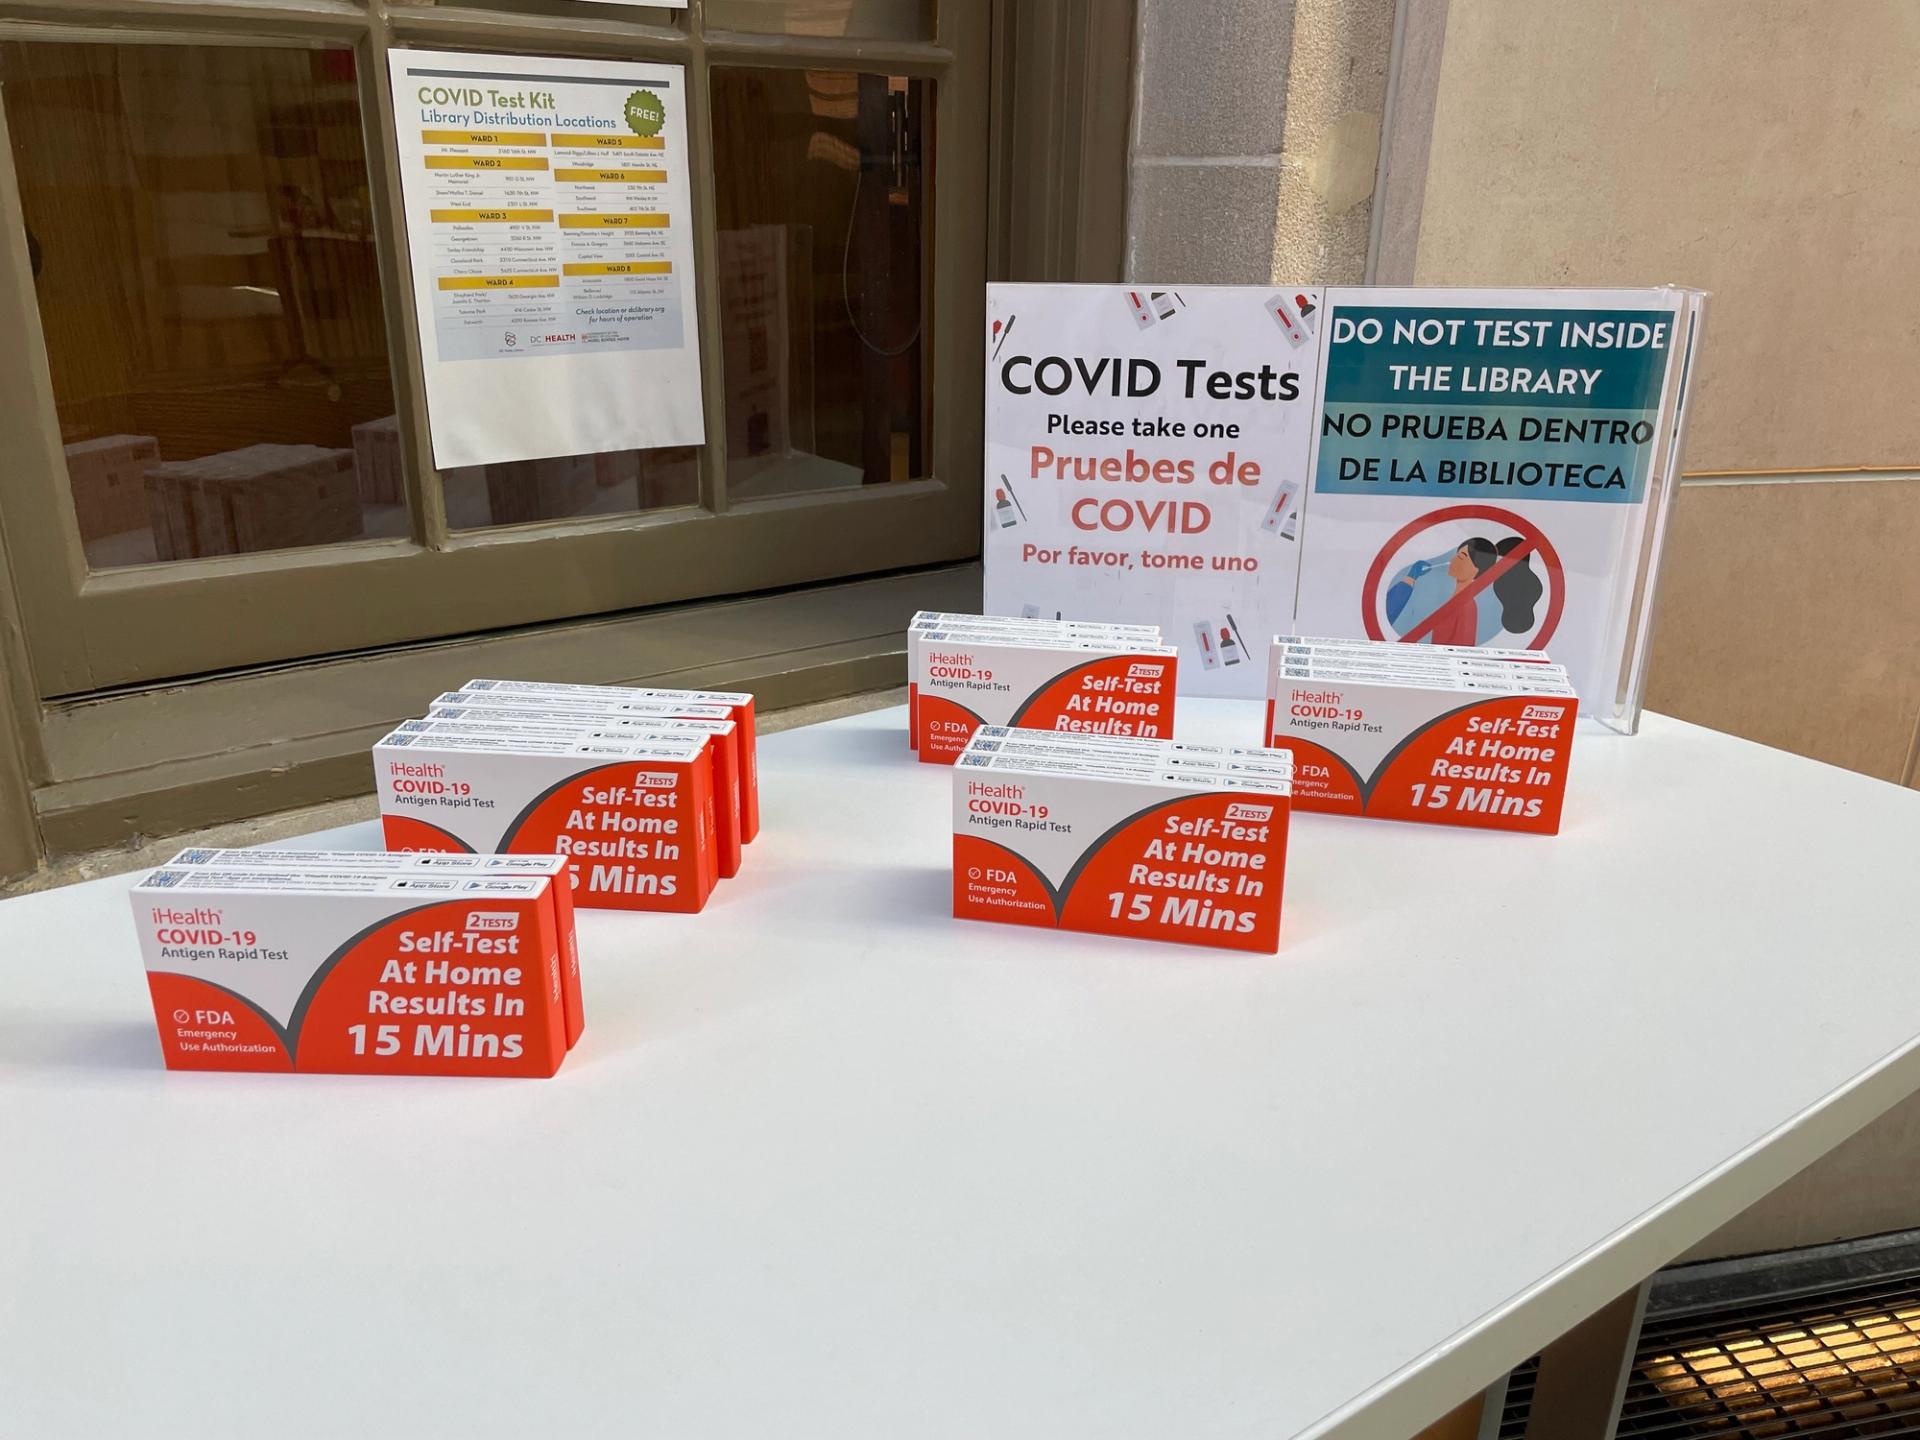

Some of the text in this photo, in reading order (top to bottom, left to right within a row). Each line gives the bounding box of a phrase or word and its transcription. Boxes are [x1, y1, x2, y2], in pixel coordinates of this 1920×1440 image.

[418, 86, 556, 110] COVID Test Kit
[421, 109, 616, 129] Library Distribution Locations
[630, 107, 660, 122] FREE!
[576, 307, 595, 315] Check
[596, 306, 619, 314] location
[628, 305, 665, 314] dclibrary.org
[589, 316, 598, 324] for
[617, 315, 624, 323] of
[624, 314, 653, 323] operation
[545, 334, 576, 342] HEALTH
[1332, 318, 1666, 350] DO NOT TEST INSIDE
[1001, 356, 1300, 401] COVID Tests
[1390, 365, 1602, 395] THE LIBRARY
[1048, 414, 1240, 438] Please take one
[1322, 413, 1654, 444] NO PRUEBA DENTRO
[1030, 446, 1261, 486] Pruebes de
[1338, 457, 1626, 490] DE LA BIBLIOTECA
[1072, 498, 1212, 534] COVID
[1022, 544, 1258, 571] Por favor, tome uno
[929, 652, 972, 666] iHealth
[930, 666, 992, 680] COVID-19
[930, 679, 1010, 692] Antigen Rapid Test
[1082, 675, 1162, 695] Self-Test
[1066, 694, 1160, 716] At Home
[1292, 690, 1340, 705] iHealth
[1290, 705, 1363, 720] COVID-19
[944, 722, 968, 734] FDA
[1056, 714, 1158, 737] Results In
[1290, 718, 1383, 733] Antigen Rapid Test
[1466, 716, 1560, 739] Self-Test
[930, 743, 944, 751] Use
[1446, 737, 1556, 763] At Home
[390, 762, 442, 778] iHealth
[1302, 765, 1330, 778] FDA
[1430, 758, 1552, 786] Results In
[392, 780, 470, 795] COVID-19
[582, 786, 677, 808] Self-Test
[968, 782, 1024, 799] iHealth
[1300, 789, 1354, 800] Authorization
[394, 796, 495, 809] Antigen Rapid Test
[968, 800, 1048, 818] COVID-19
[1410, 784, 1543, 818] 15 Mins
[566, 810, 679, 834] At Home
[968, 815, 1072, 833] Antigen Rapid Test
[1164, 816, 1270, 842] Self-Test
[556, 834, 680, 860] Results In
[1144, 839, 1266, 870] At Home
[588, 865, 677, 896] Mins
[986, 869, 1017, 883] FDA
[1128, 864, 1264, 897] Results In
[968, 882, 1017, 896] Emergency
[968, 894, 1046, 910] Use Authorization
[152, 908, 220, 925] iHealth
[1107, 892, 1256, 933] 15 Mins
[156, 929, 256, 945] COVID-19
[399, 931, 518, 954] Self-Test
[161, 947, 288, 961] Antigen Rapid Test
[380, 960, 521, 986] At Home
[368, 991, 524, 1016] Results In
[196, 1010, 235, 1025] FDA
[177, 1028, 237, 1040] Emergency
[348, 1024, 524, 1058] 15 Mins
[180, 1042, 276, 1053] Use Authorization
